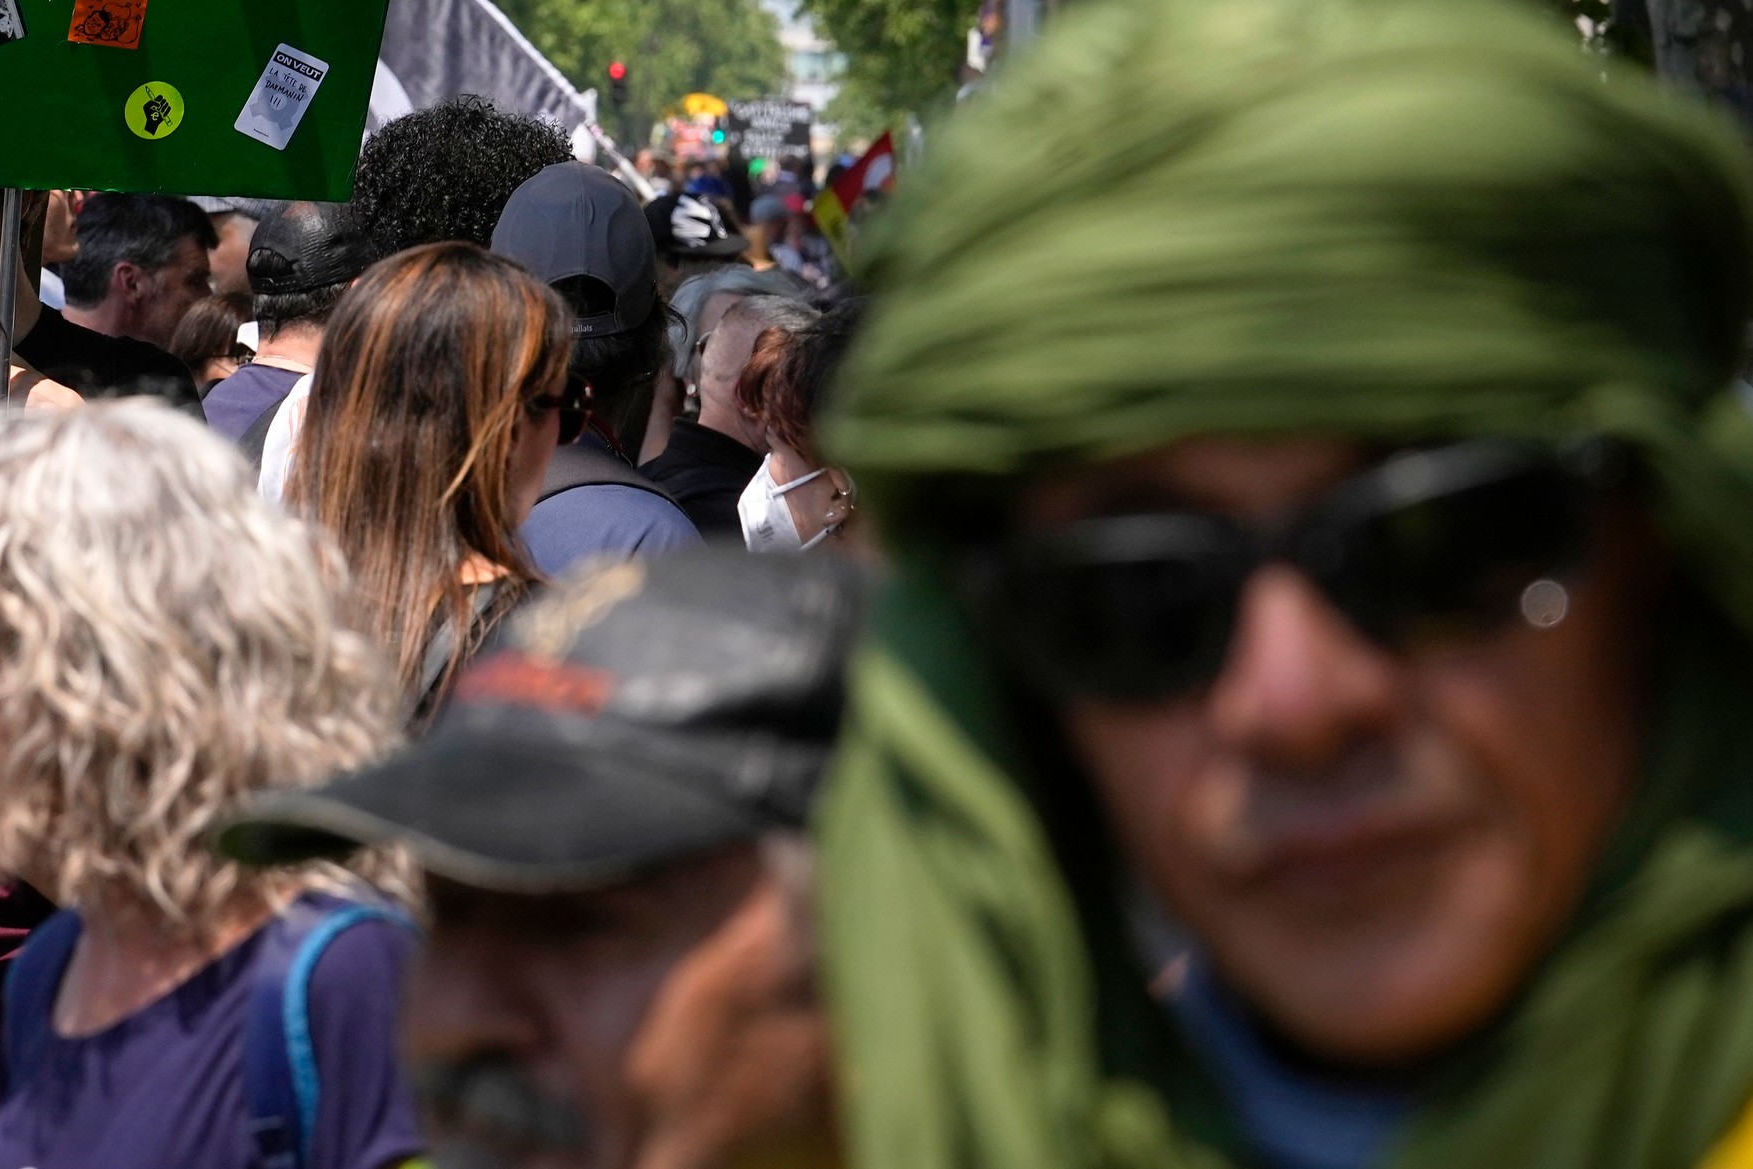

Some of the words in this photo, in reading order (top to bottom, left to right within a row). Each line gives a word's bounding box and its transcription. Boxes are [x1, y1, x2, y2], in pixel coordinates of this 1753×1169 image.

[276, 54, 292, 68] ON
[292, 61, 322, 79] VEUT
[265, 80, 306, 102] DARMANIN
